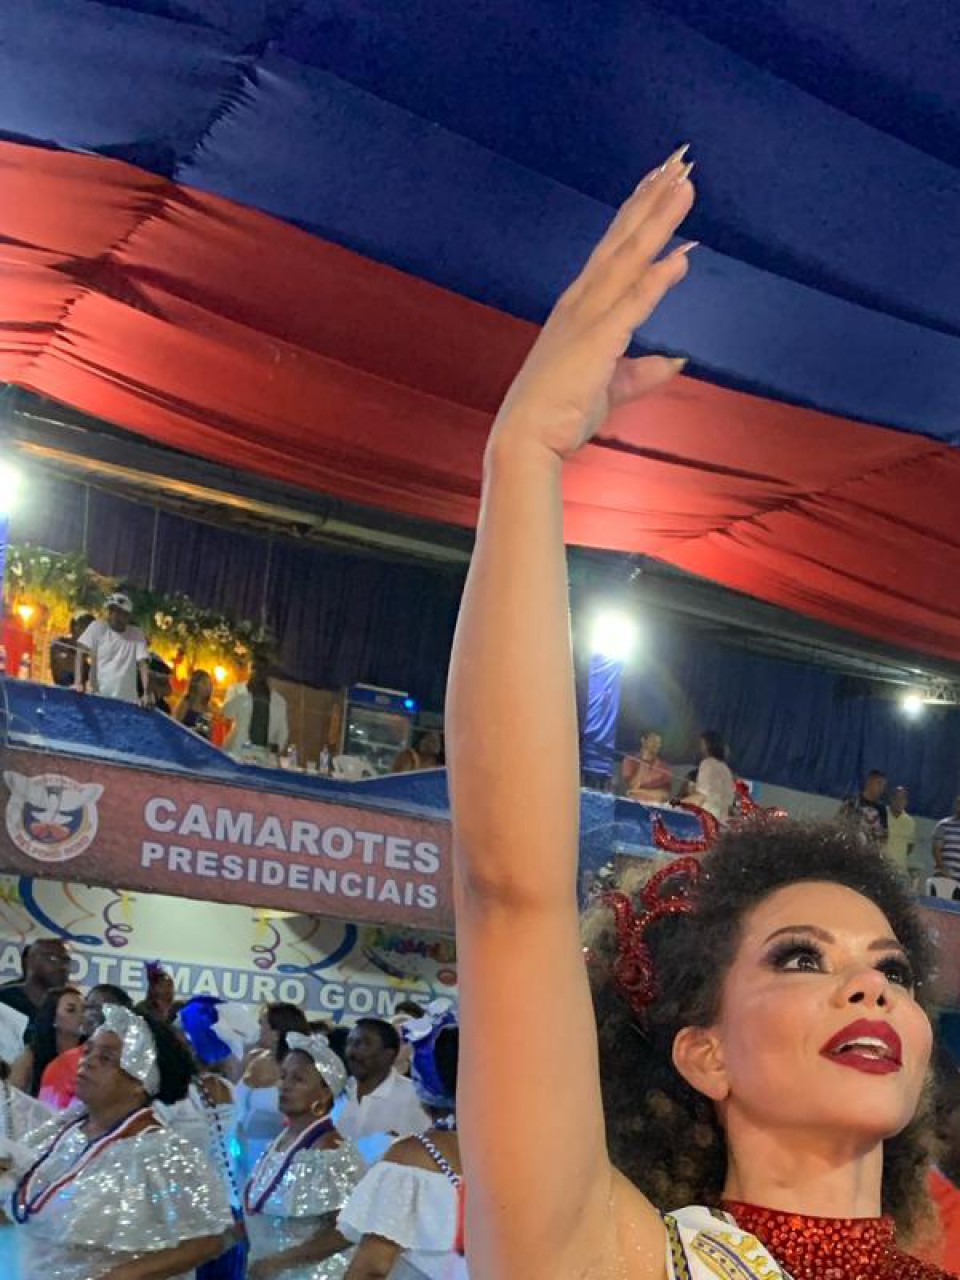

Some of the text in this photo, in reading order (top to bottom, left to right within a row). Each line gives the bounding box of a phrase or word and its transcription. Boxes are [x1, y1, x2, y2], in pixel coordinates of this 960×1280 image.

[143, 797, 440, 874] CAMAROTES
[140, 841, 438, 909] PRESIDENCIAIS
[0, 946, 145, 989] AOTE
[319, 982, 454, 1016] GOM
